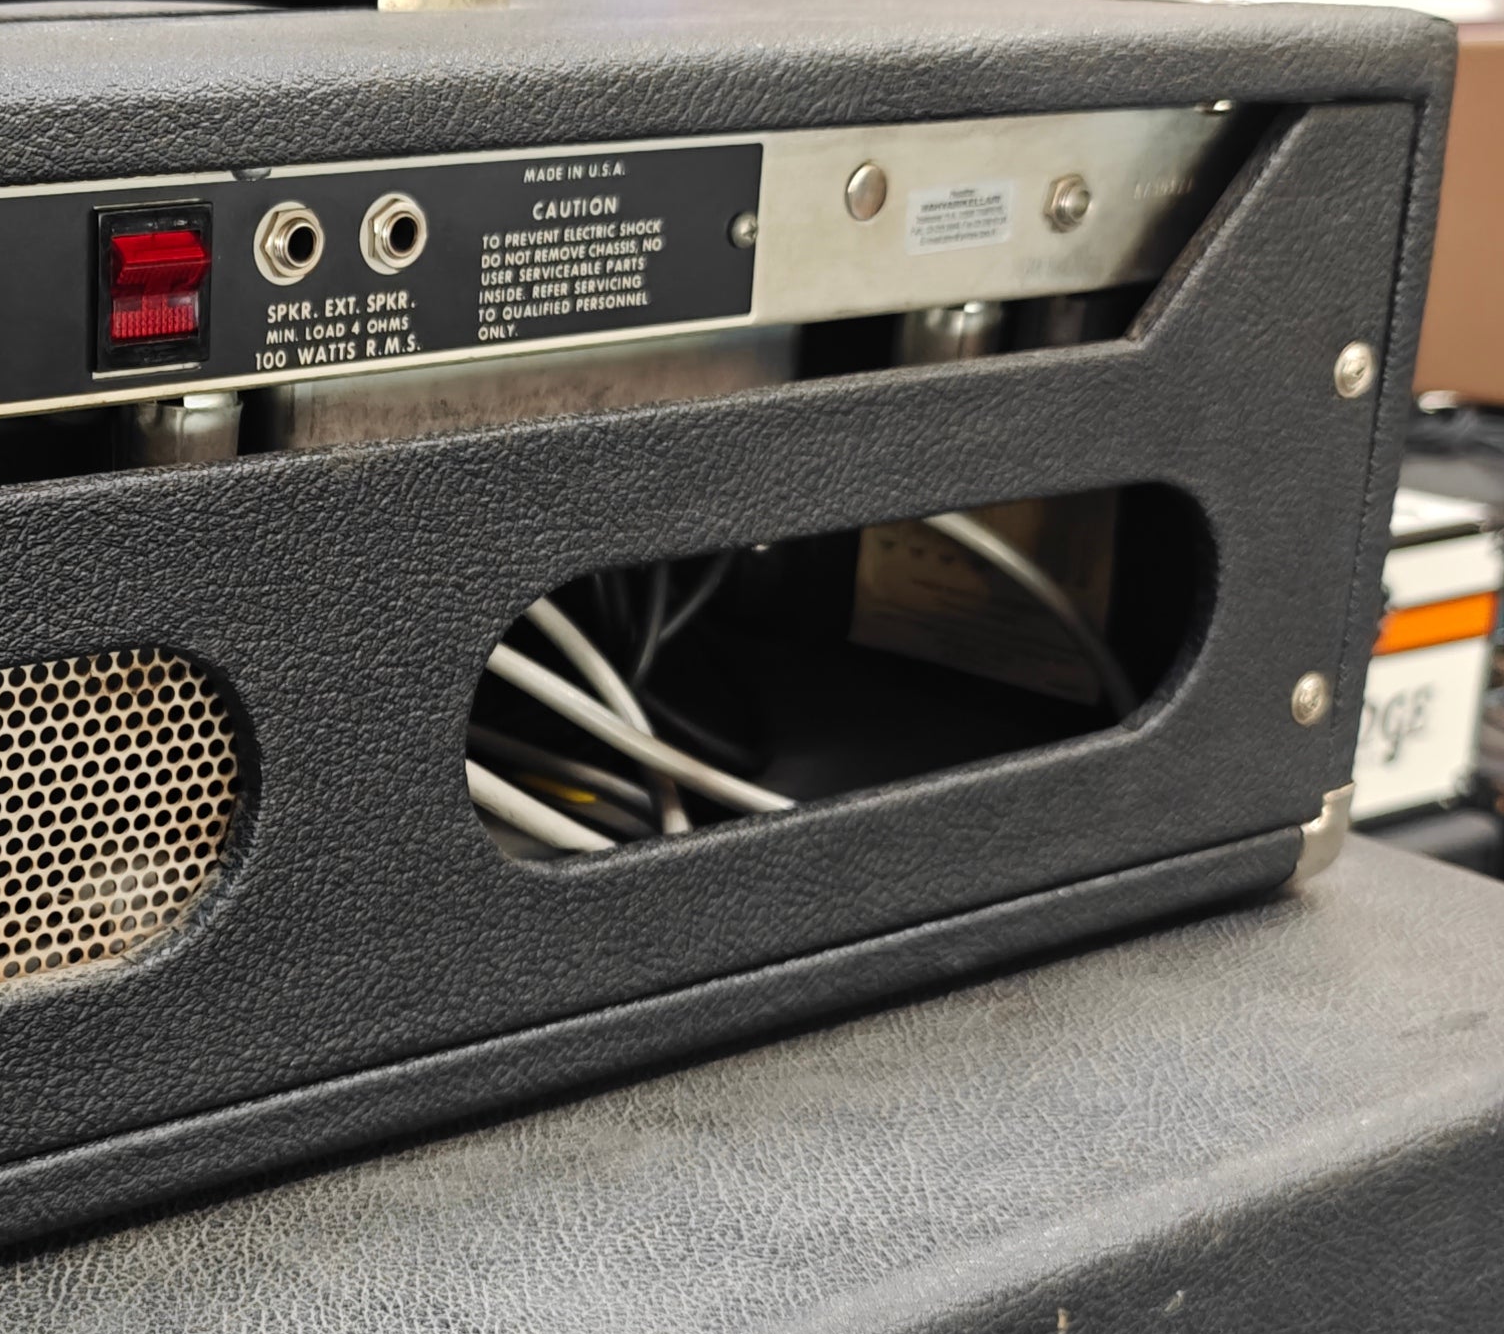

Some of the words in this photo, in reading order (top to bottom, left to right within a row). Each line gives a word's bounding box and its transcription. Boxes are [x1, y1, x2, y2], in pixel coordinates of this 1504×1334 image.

[523, 168, 563, 183] MADE
[568, 166, 583, 180] IN
[588, 161, 625, 178] U.S.A.
[532, 196, 618, 220] CAUTION
[483, 235, 500, 249] TO
[505, 229, 560, 248] PREVENT
[564, 224, 615, 242] ELECTRIC
[620, 219, 662, 237] SHOCK
[481, 254, 501, 268] DO
[505, 251, 531, 266] NOT
[534, 246, 585, 263] REMOVE
[643, 238, 662, 252] NO
[481, 271, 512, 286] USER
[519, 262, 601, 282] SERVICEABLE
[606, 257, 645, 273] PARTS
[479, 288, 526, 304] INSIDE.
[532, 283, 568, 299] REFER
[574, 276, 642, 295] SERVICING
[267, 301, 318, 323] SPKR.
[325, 297, 360, 317] EXT.
[367, 291, 415, 313] SPKR.
[478, 308, 496, 322] TO
[502, 300, 570, 320] QUALIFIED
[576, 293, 648, 312] PERSONNEL
[266, 329, 298, 344] MIN.
[305, 323, 345, 341] LOAD
[351, 322, 359, 335] 4
[367, 317, 409, 334] OHMS
[478, 325, 518, 340] ONLY.
[255, 350, 286, 371] 100
[298, 343, 355, 365] WATTS
[366, 334, 421, 357] R.M.S.
